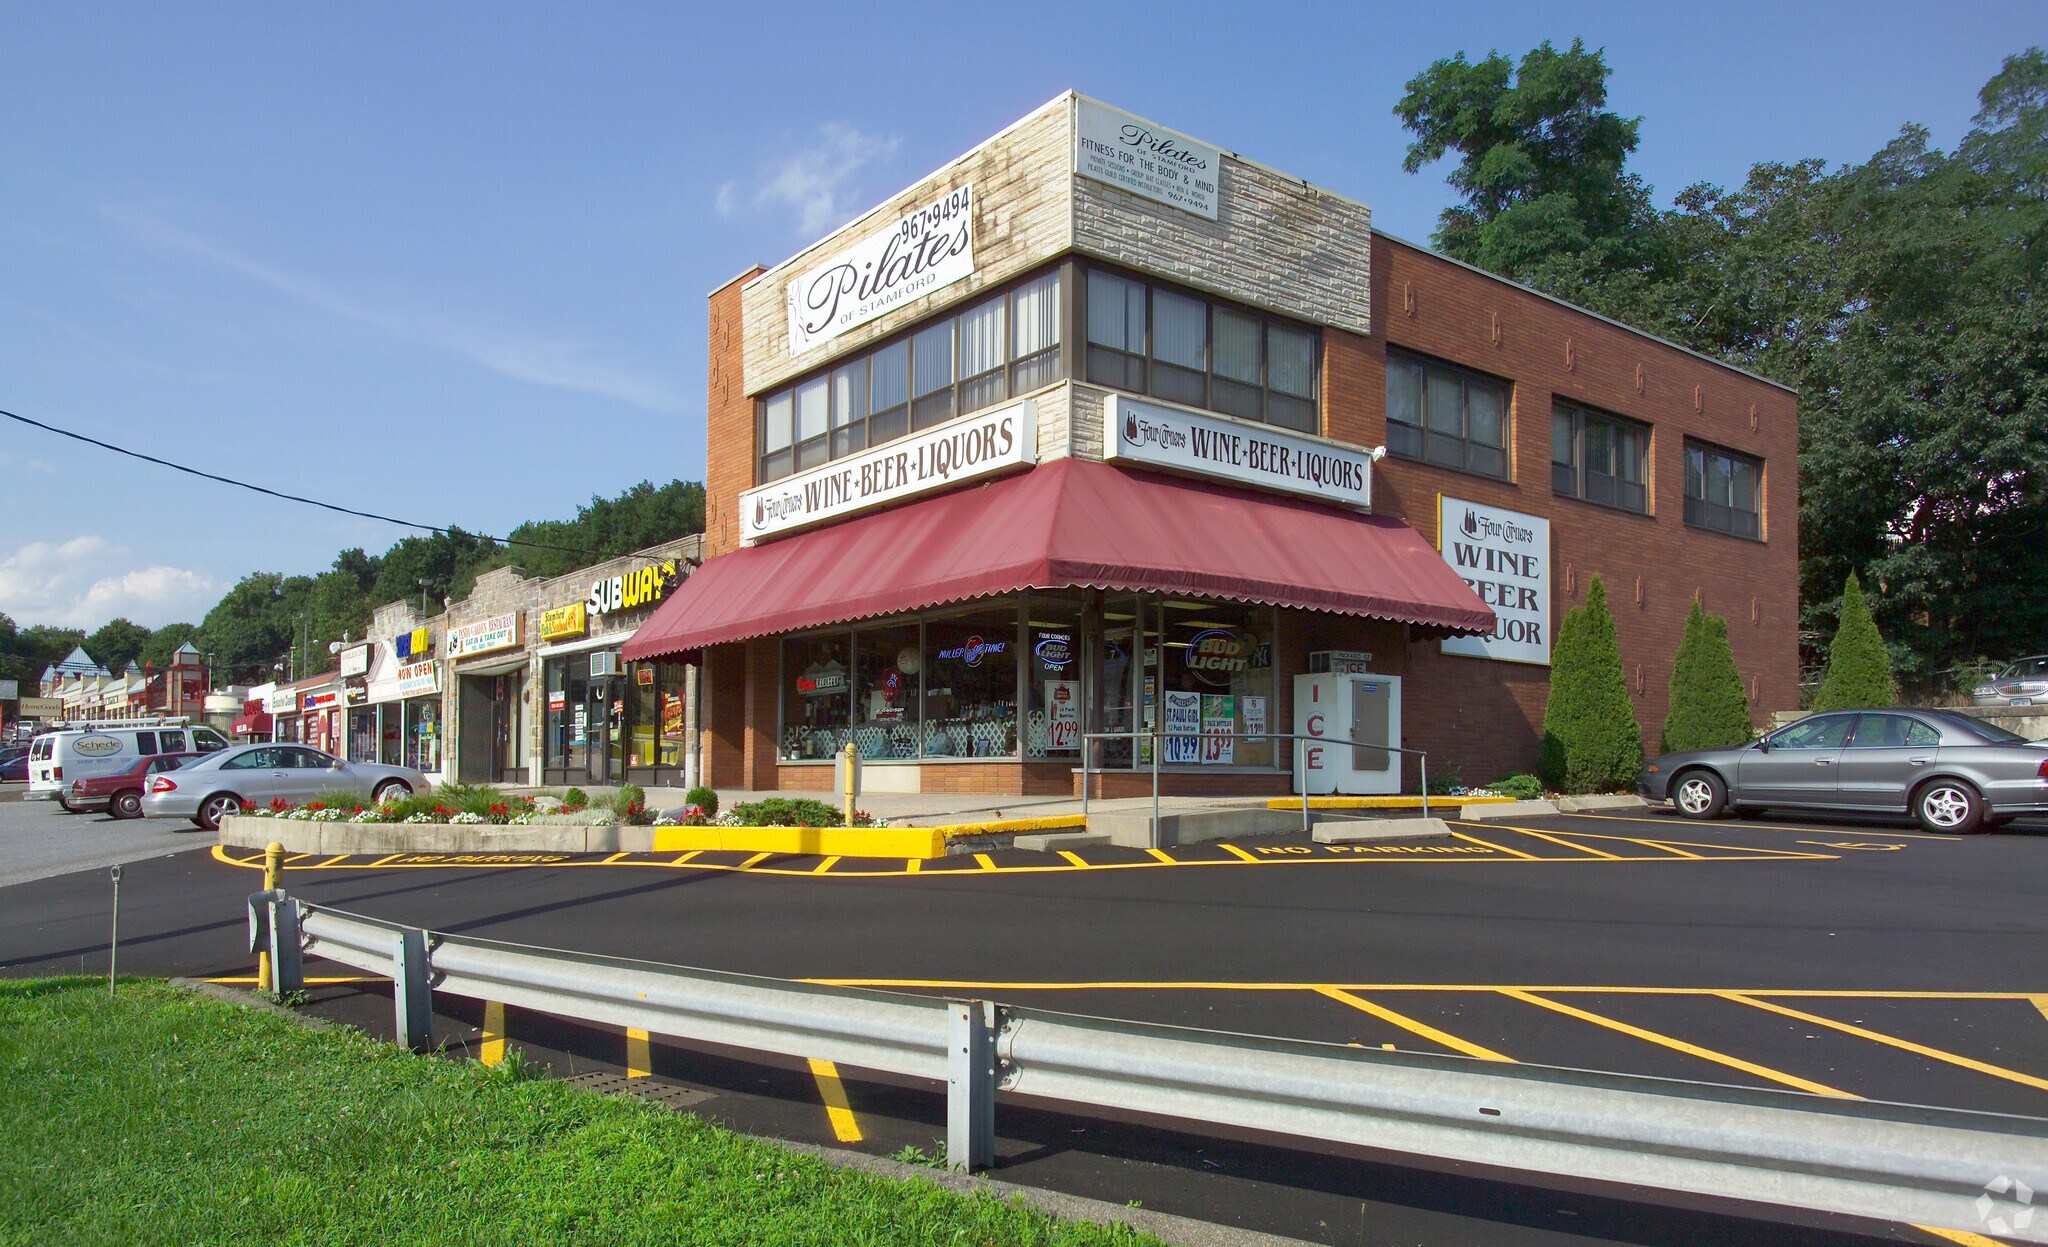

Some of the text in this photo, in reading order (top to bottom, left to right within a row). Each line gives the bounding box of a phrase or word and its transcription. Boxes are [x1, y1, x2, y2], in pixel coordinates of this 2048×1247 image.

[1118, 124, 1206, 170] Pilates
[1081, 137, 1214, 194] FITNESS FOR THE BODY & MIND
[1152, 153, 1196, 174] STAMFORD
[806, 220, 968, 334] Pilates
[840, 273, 936, 325] OF STAMFORD
[1138, 419, 1363, 492] Four Corners WINE BEER LIQUORS
[804, 469, 852, 514] WINE
[860, 452, 908, 498] BEER
[917, 417, 1013, 481] LIQUORS
[1478, 516, 1533, 544] Four Corners
[1453, 542, 1540, 580] WINE
[938, 648, 964, 660] MILLER
[984, 642, 1006, 654] TIME!
[1041, 650, 1071, 658] LIGHT
[1045, 644, 1068, 652] BUD
[1199, 639, 1240, 655] BUD
[398, 662, 432, 681] NOW OPEN
[1044, 663, 1064, 672] OPEN
[1188, 656, 1247, 672] LIGHT
[1346, 664, 1364, 673] ICE
[22, 702, 62, 711] HomeGoods
[1255, 846, 1494, 854] NO PARKING
